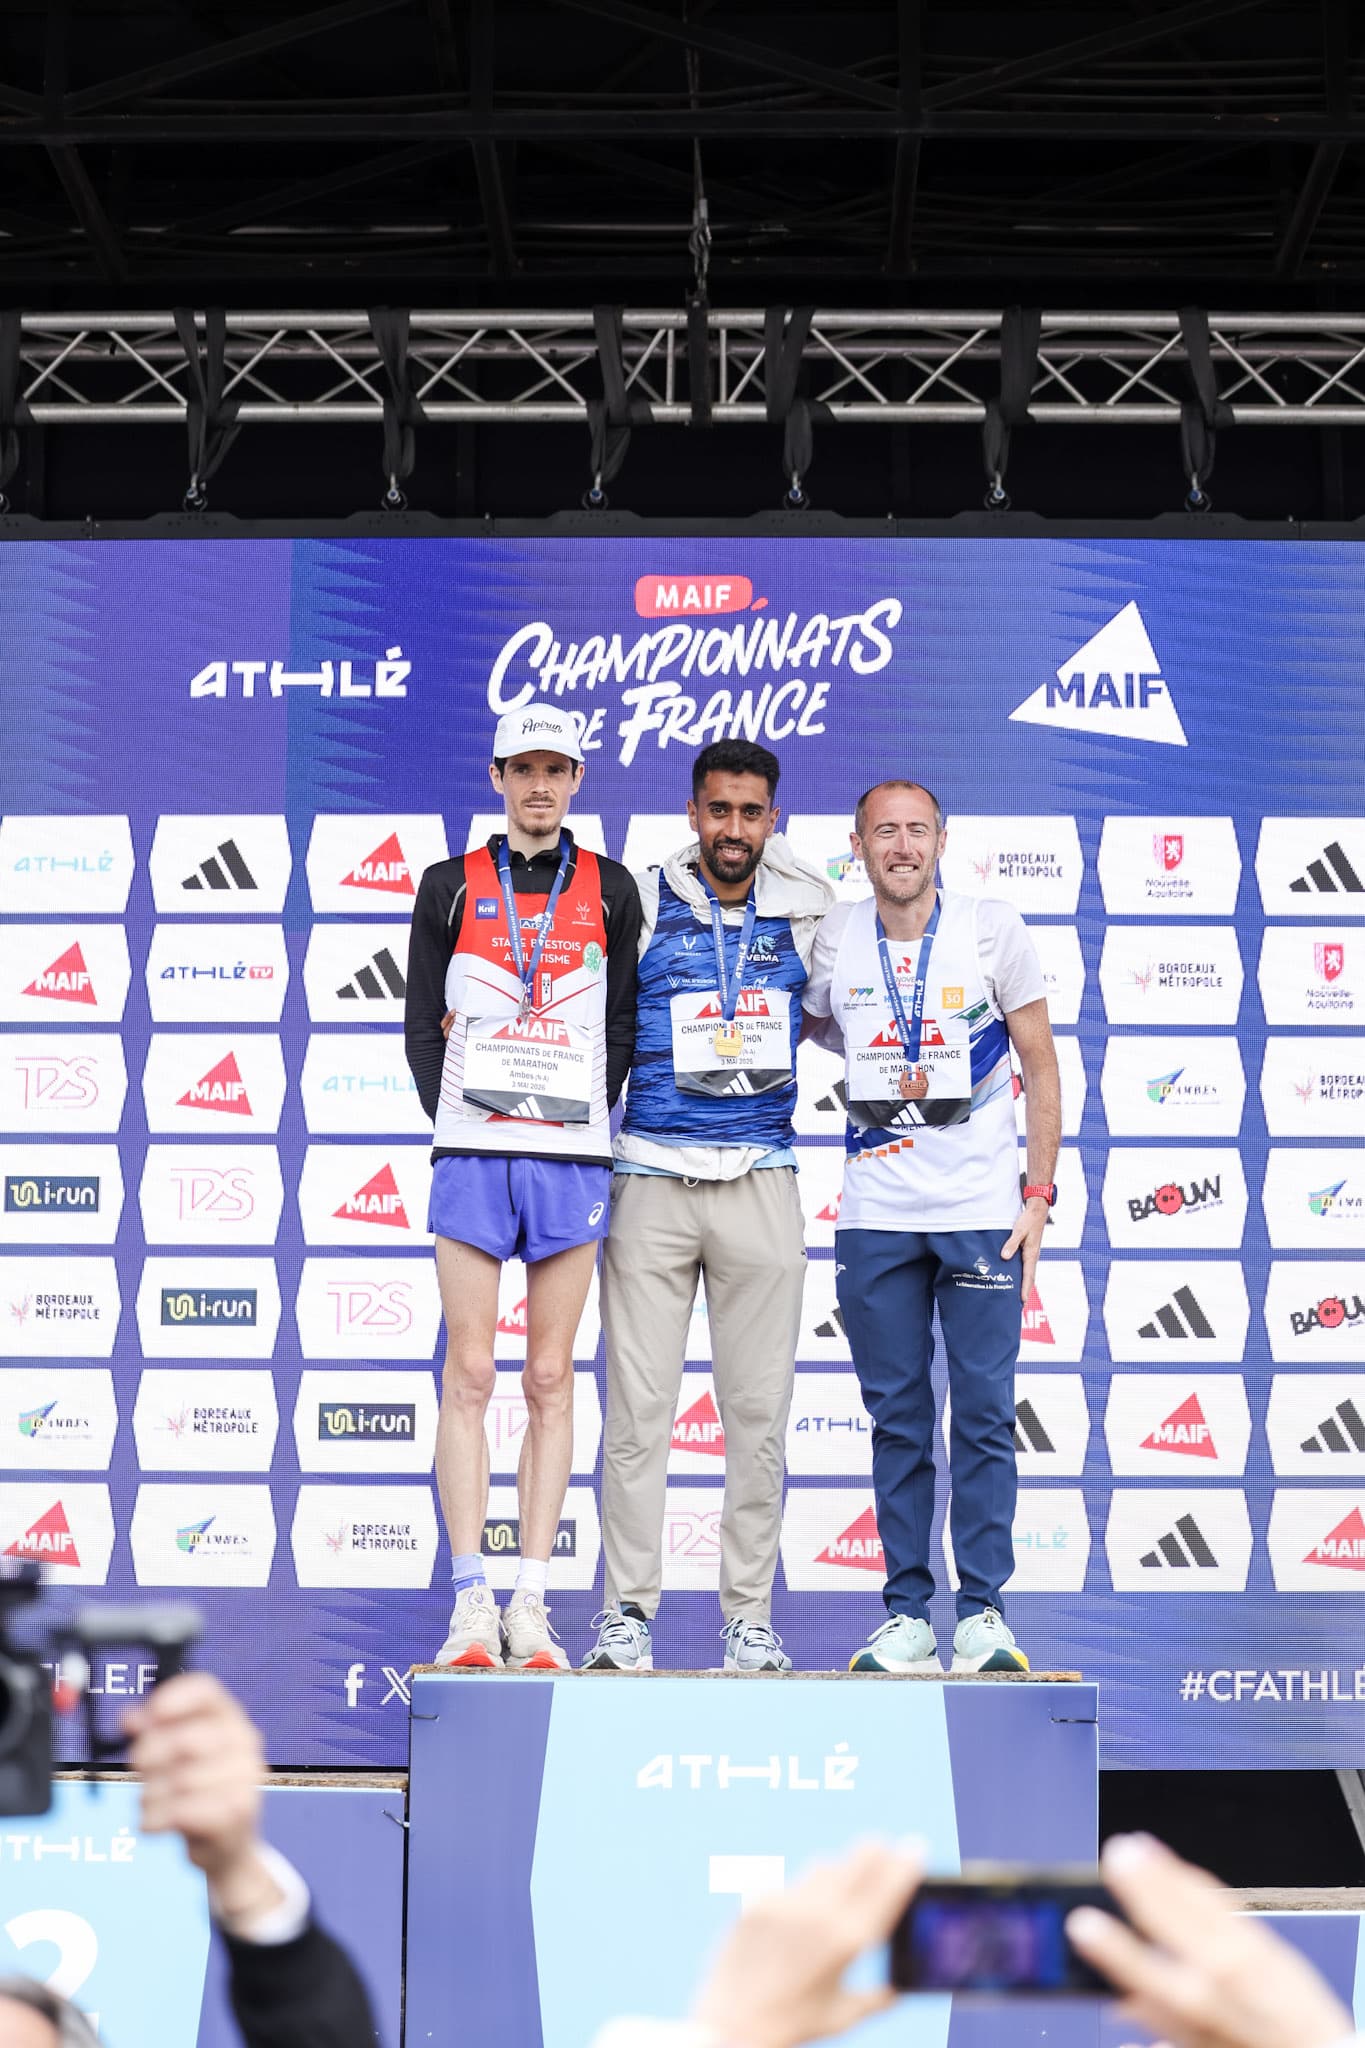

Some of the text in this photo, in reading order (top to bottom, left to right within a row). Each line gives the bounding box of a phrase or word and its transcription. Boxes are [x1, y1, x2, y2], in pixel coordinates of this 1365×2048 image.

[655, 584, 732, 608] MAIF
[487, 598, 903, 716] CHAMPIONNATS
[190, 646, 413, 699] ATHLÉ
[1046, 673, 1165, 709] MAIF
[522, 718, 563, 735] Apirun
[619, 679, 832, 768] FRANCE
[14, 850, 114, 872] ATHLÉ
[999, 853, 1056, 864] BORDEAUX
[353, 862, 409, 882] MAIF
[999, 865, 1063, 878] MÉTROPOLE
[478, 905, 496, 914] Krill
[492, 937, 581, 951] STAE BESTOIS
[503, 953, 570, 965] ATLTISME
[735, 942, 748, 979] ATHLÉ
[746, 954, 779, 962] VEMA
[160, 961, 273, 979] ATHLÉ TV
[1159, 963, 1216, 974] BORDEAUX
[35, 971, 90, 992] MAIF
[1159, 975, 1223, 988] MÉTROPOLE
[914, 979, 925, 1017] ATHLÉ
[508, 1021, 566, 1040] MAIF
[681, 1022, 744, 1034] CHAMPIONTS
[756, 1021, 782, 1030] FRANCE
[882, 1022, 939, 1042] MIF
[475, 1043, 584, 1063] CHAMPIONNATS DE FRANCE
[856, 1051, 906, 1061] CHAMPIONNA
[928, 1050, 961, 1060] FRANCE
[502, 1058, 558, 1071] DE MARATHON
[880, 1065, 935, 1074] DE MARHON
[189, 1081, 246, 1101] MAIF
[517, 1081, 529, 1089] MAI
[1320, 1086, 1365, 1099] MÉTROP
[44, 1181, 96, 1205] i-run
[346, 1194, 403, 1214] MAIF
[36, 1295, 94, 1305] BORDEAUX
[200, 1294, 252, 1318] i-run
[36, 1306, 100, 1319] MÉTROPOLE
[1290, 1294, 1365, 1335] BAOU
[194, 1408, 251, 1419] BORDEAUX
[358, 1408, 411, 1433] i-run
[193, 1420, 258, 1433] MÉTROPOLE
[671, 1422, 725, 1442] MAIF
[795, 1417, 877, 1432] ATHL
[1152, 1424, 1210, 1444] MAIF
[352, 1524, 410, 1536] BORDEAUX
[1012, 1526, 1069, 1549] HLÉ
[17, 1532, 75, 1552] MAIF
[352, 1536, 417, 1550] MÉTROPOLE
[828, 1538, 884, 1559] MAIF
[636, 1741, 859, 1790] ATHLÉ
[0, 1828, 137, 1862] THLÉ
